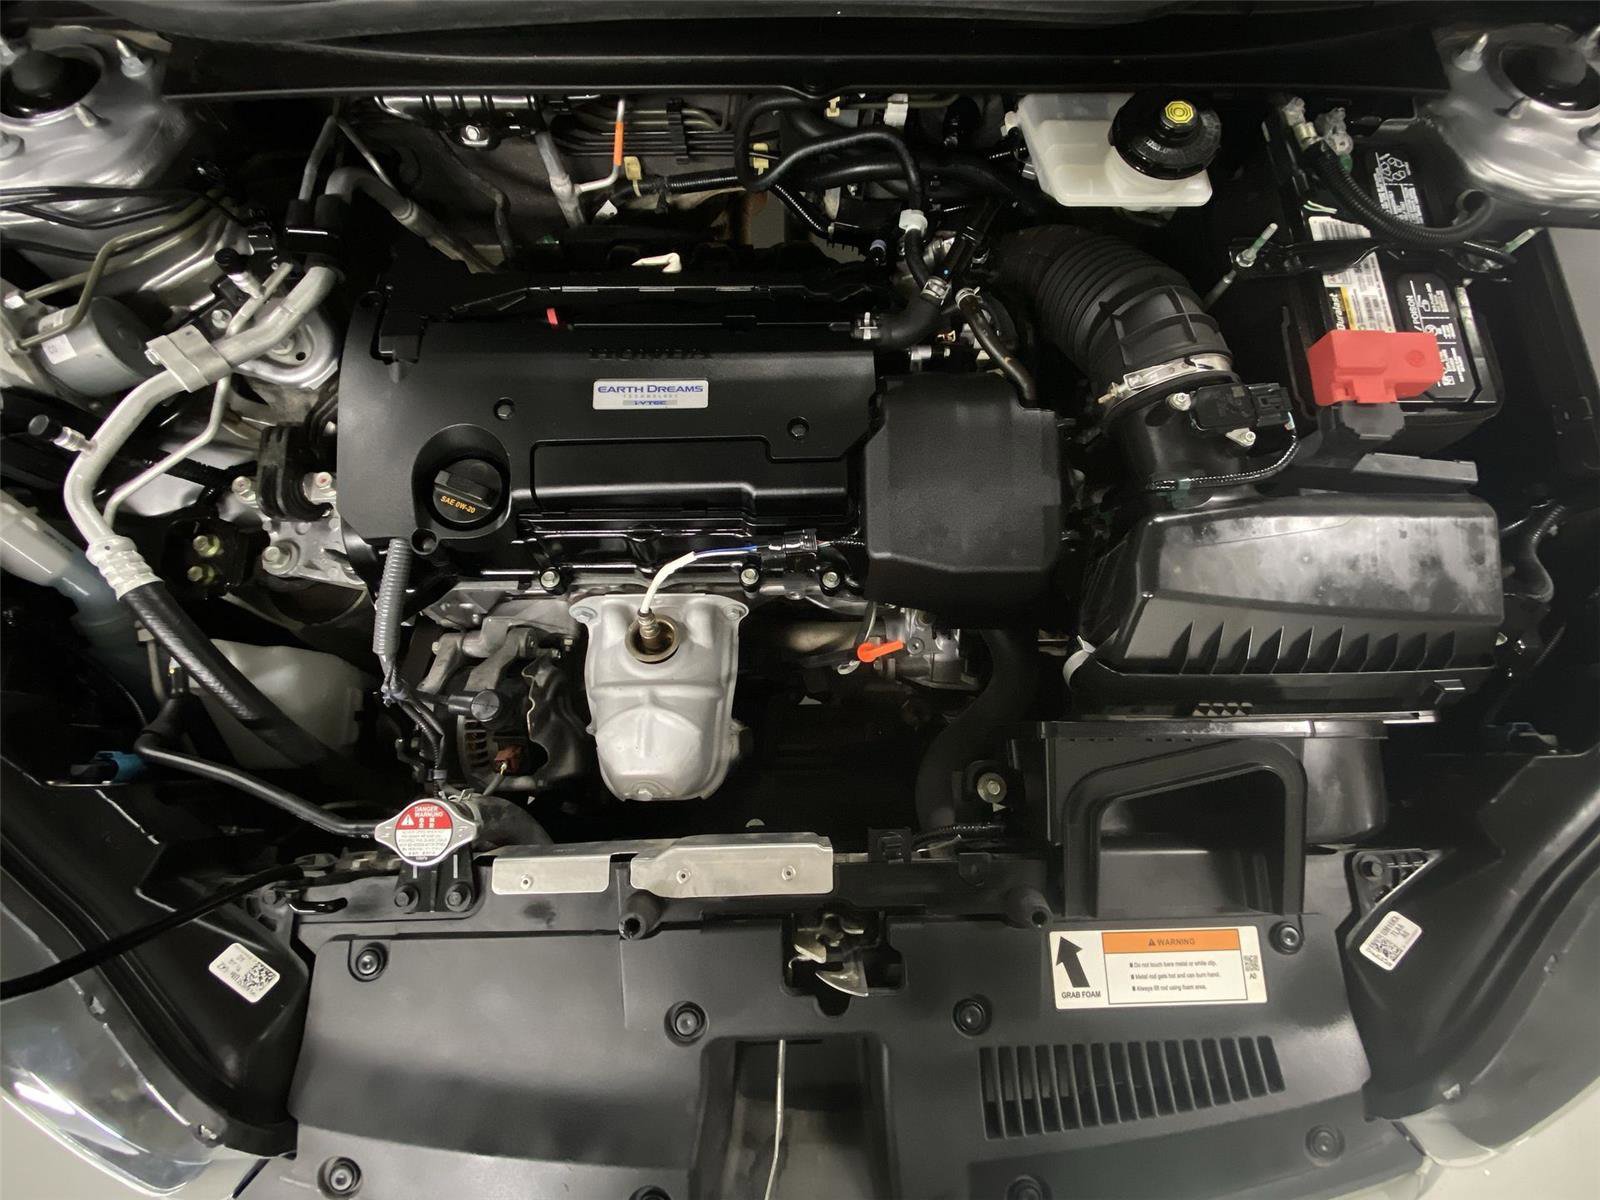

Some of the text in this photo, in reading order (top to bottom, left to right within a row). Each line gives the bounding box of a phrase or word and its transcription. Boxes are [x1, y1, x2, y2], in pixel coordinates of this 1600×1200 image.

[1405, 295, 1420, 325] POISON
[597, 385, 644, 393] EARTH
[440, 495, 476, 513] SAE 0W-20
[1157, 938, 1195, 946] WARNING
